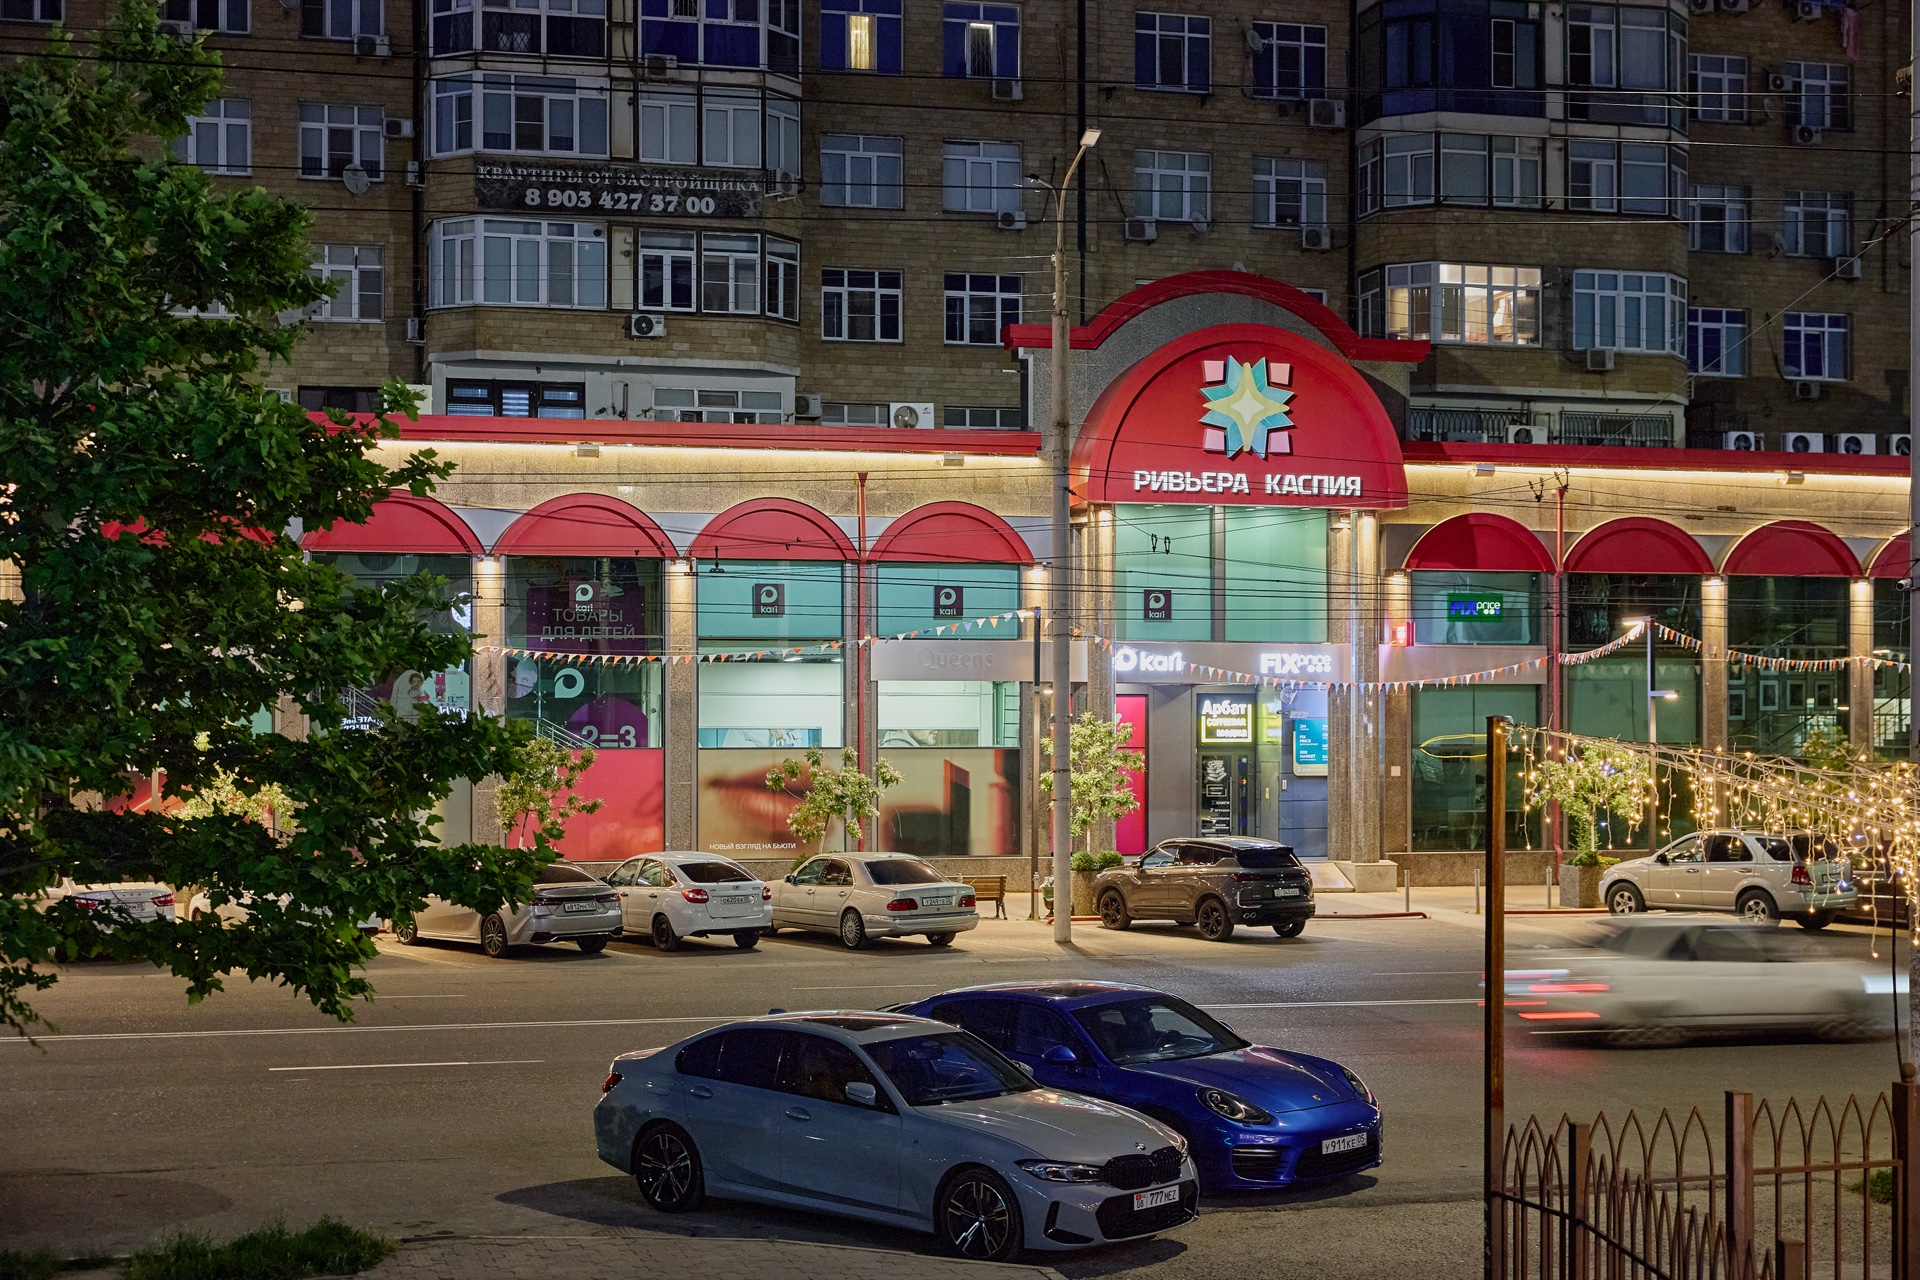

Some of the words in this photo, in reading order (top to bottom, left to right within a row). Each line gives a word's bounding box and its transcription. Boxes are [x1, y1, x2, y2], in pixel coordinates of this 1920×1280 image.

[476, 165, 584, 184] КВАРТИРЫ
[587, 170, 613, 185] ОТ
[616, 171, 760, 194] ЗАСТРОЙЩИКА
[524, 188, 541, 206] 8
[546, 188, 593, 209] 903
[598, 190, 643, 211] 427
[649, 194, 679, 213] 37
[685, 196, 716, 215] 00
[1133, 470, 1250, 494] РИВЬЕРА
[1264, 473, 1362, 497] КАСПИЯ
[552, 608, 623, 622] ТОВАРЫ
[575, 603, 594, 612] kari
[760, 605, 779, 614] kari
[939, 607, 957, 616] kari
[1148, 610, 1165, 619] kari
[1450, 601, 1479, 616] FIX
[1476, 601, 1501, 611] price
[540, 626, 575, 642] ДЛЯ
[580, 624, 636, 642] ДЕТЕЙ
[917, 648, 994, 669] Queens
[1140, 651, 1183, 671] kari
[1260, 653, 1300, 674] FIX
[1201, 700, 1247, 718] Арбат
[581, 725, 637, 748] 2=3
